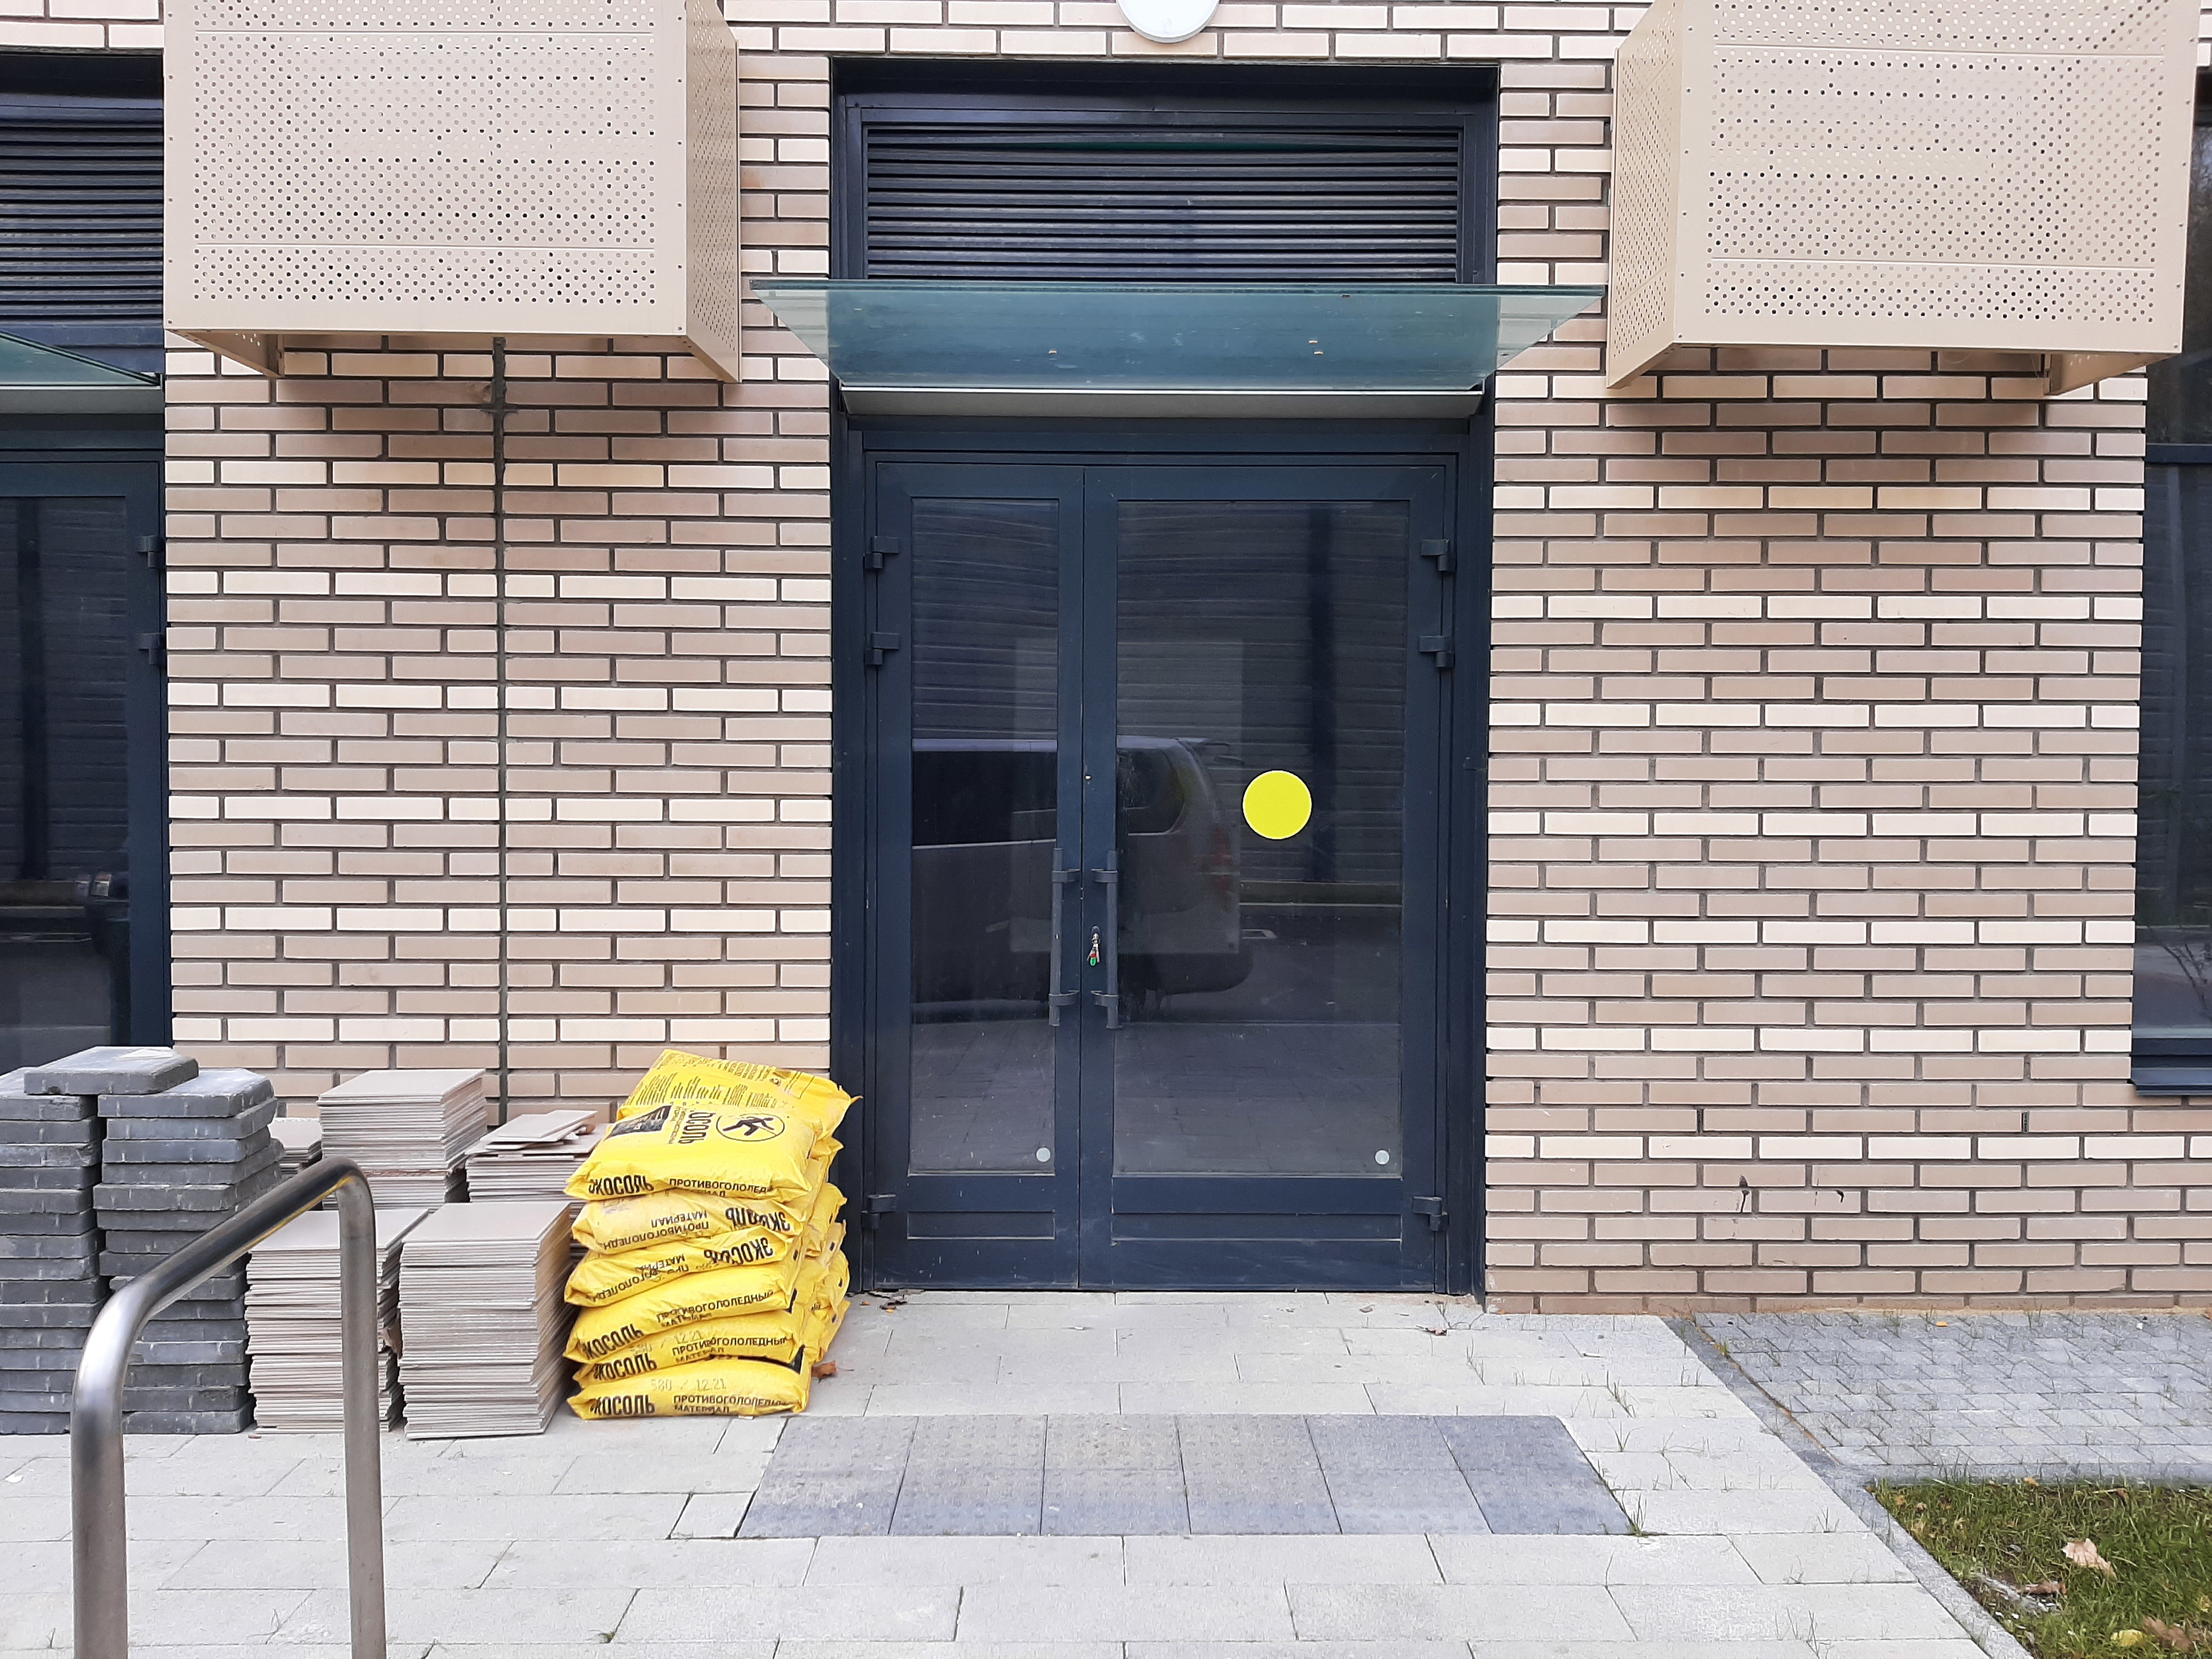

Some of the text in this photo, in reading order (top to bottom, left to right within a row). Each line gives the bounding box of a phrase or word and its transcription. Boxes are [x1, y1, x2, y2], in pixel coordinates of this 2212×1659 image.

[678, 1110, 716, 1144] ОСОЛЬ
[651, 1210, 707, 1228] МАТЕРИАЛ
[725, 1206, 791, 1232] ЭКООЛЬ
[600, 1221, 709, 1250] ПРОТИВОГОЛОЛЕДН
[583, 1323, 644, 1359] КОСОЛЬ
[594, 1353, 657, 1380] КОСОЛЬ
[590, 1395, 656, 1415] КОСОЛЬ
